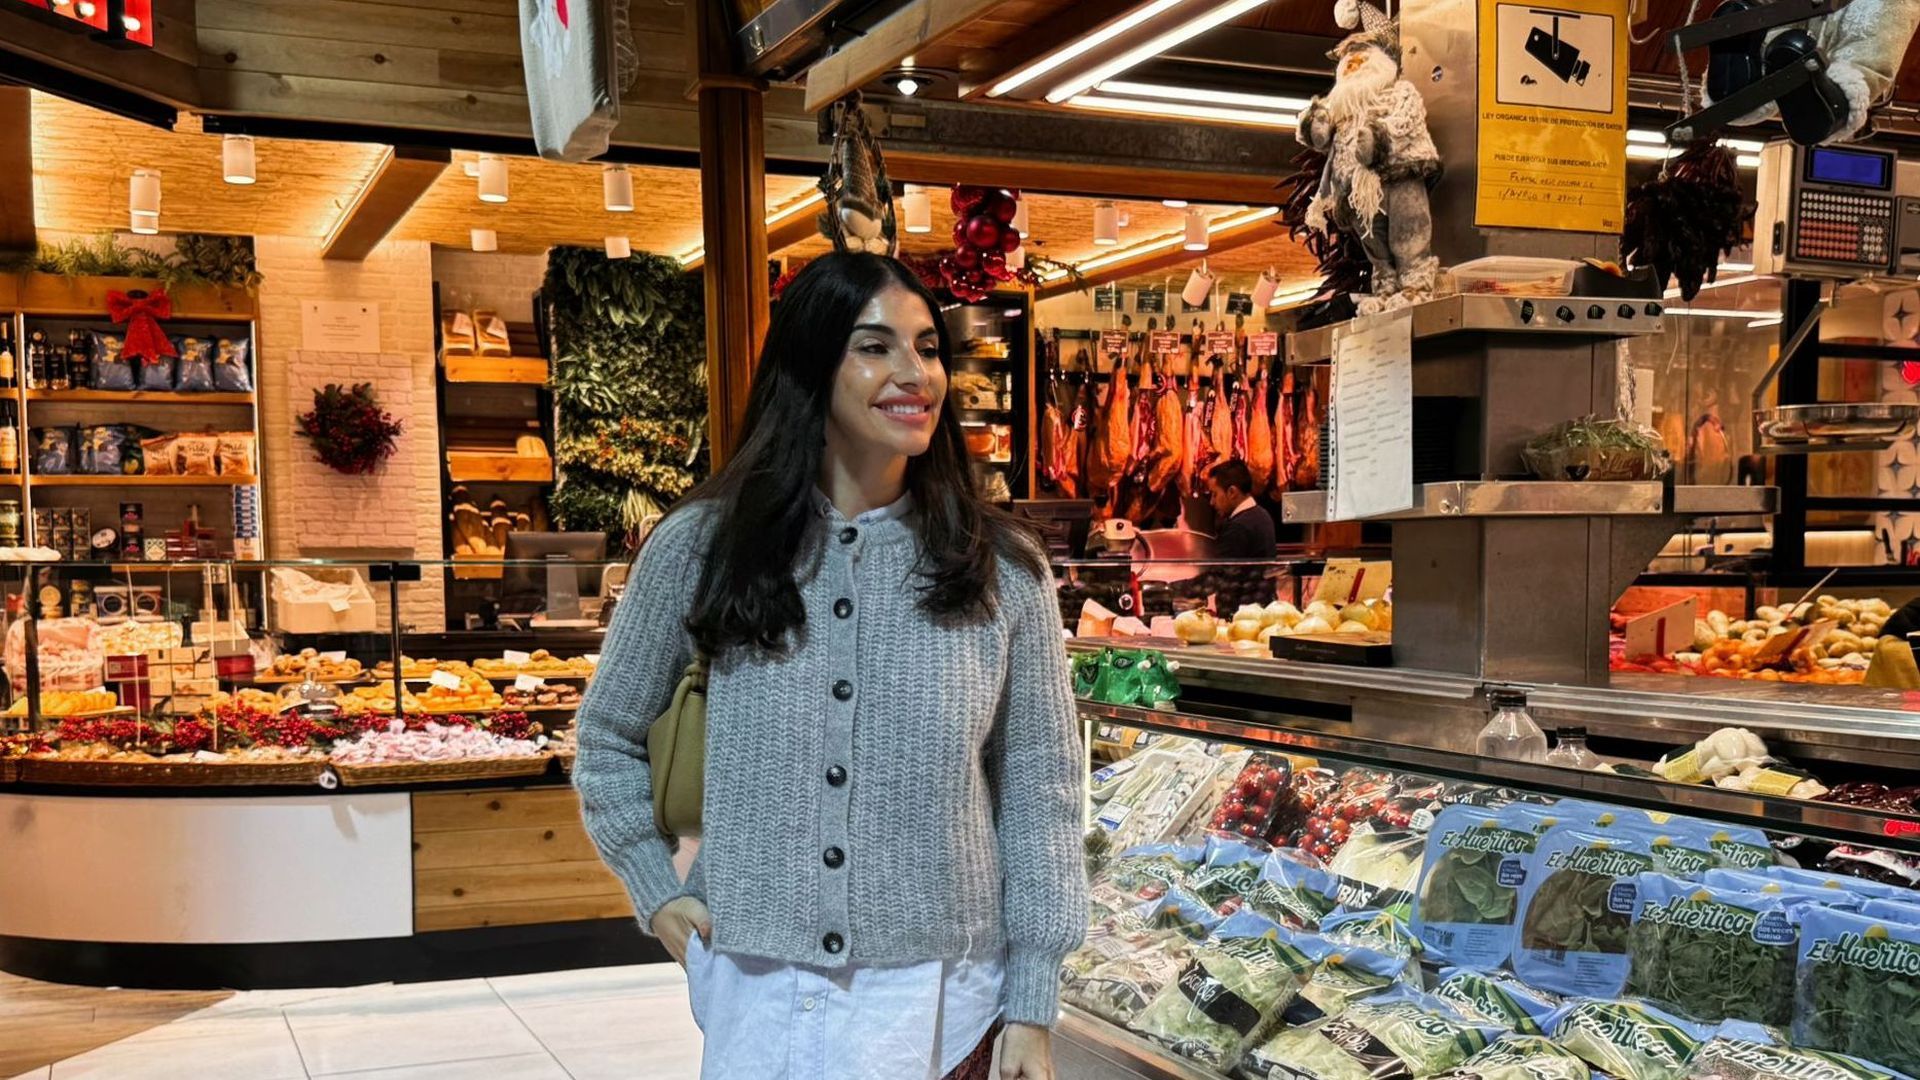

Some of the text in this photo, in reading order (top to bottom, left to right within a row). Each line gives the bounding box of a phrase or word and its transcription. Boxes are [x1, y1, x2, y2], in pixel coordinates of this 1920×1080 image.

[1482, 112, 1494, 120] LEY
[1456, 825, 1528, 853] Huertico
[1560, 845, 1643, 877] Huertico
[1656, 896, 1752, 935] Huertico
[1829, 931, 1920, 976] Huertic
